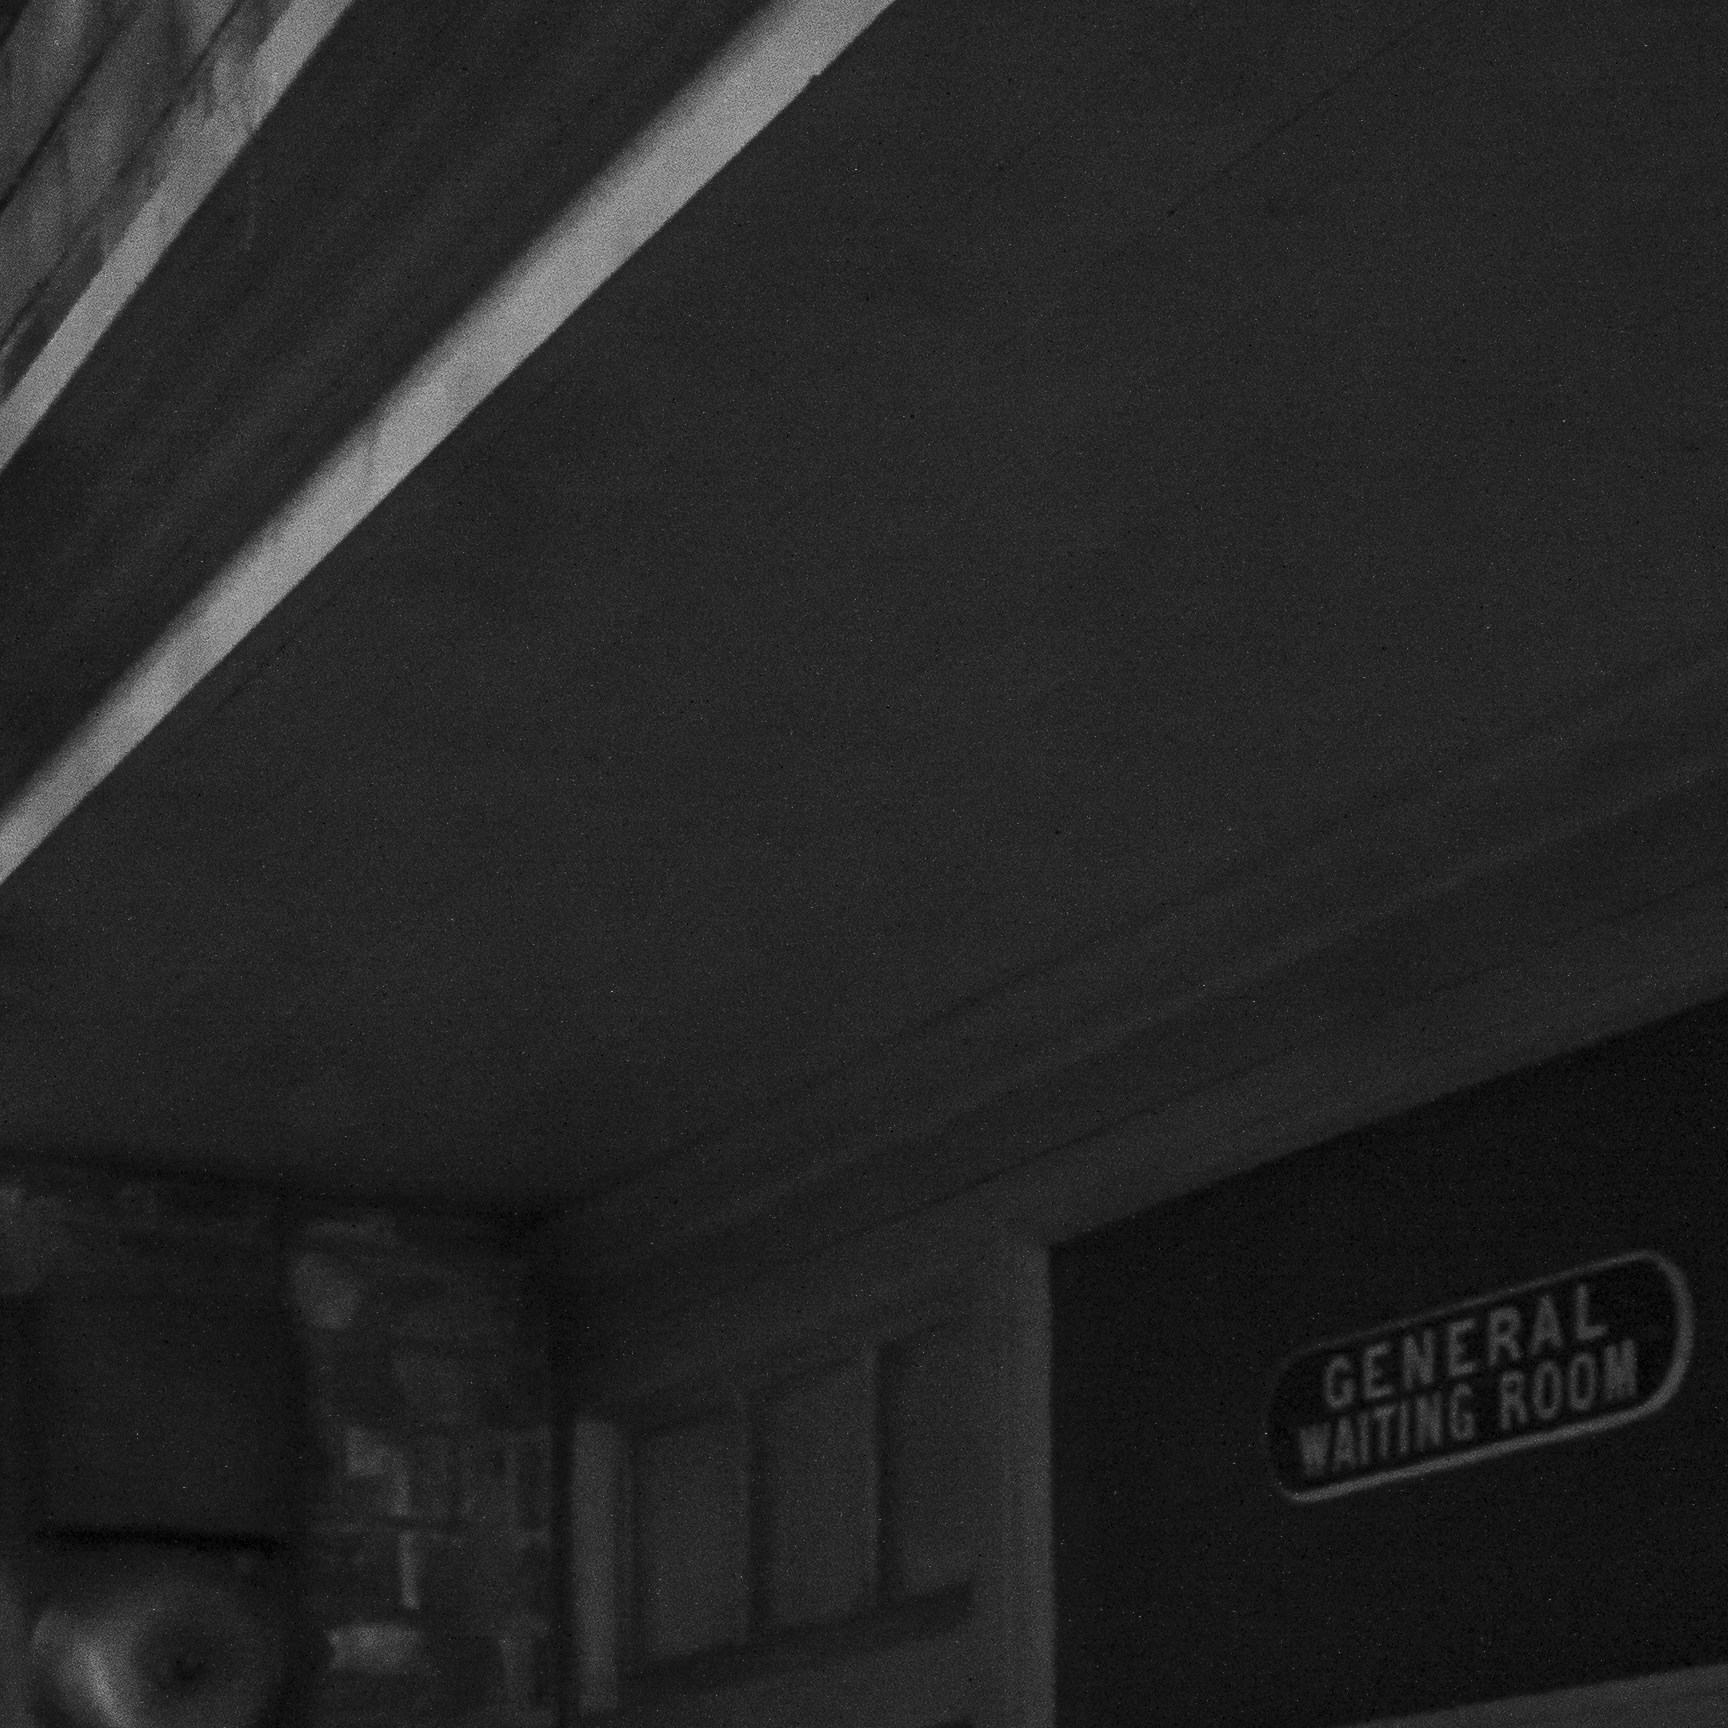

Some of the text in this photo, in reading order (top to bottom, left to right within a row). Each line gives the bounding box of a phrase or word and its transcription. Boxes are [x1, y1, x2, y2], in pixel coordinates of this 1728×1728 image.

[1299, 1338, 1638, 1477] WAITING ROOM
[1323, 1282, 1609, 1411] GENERAL
